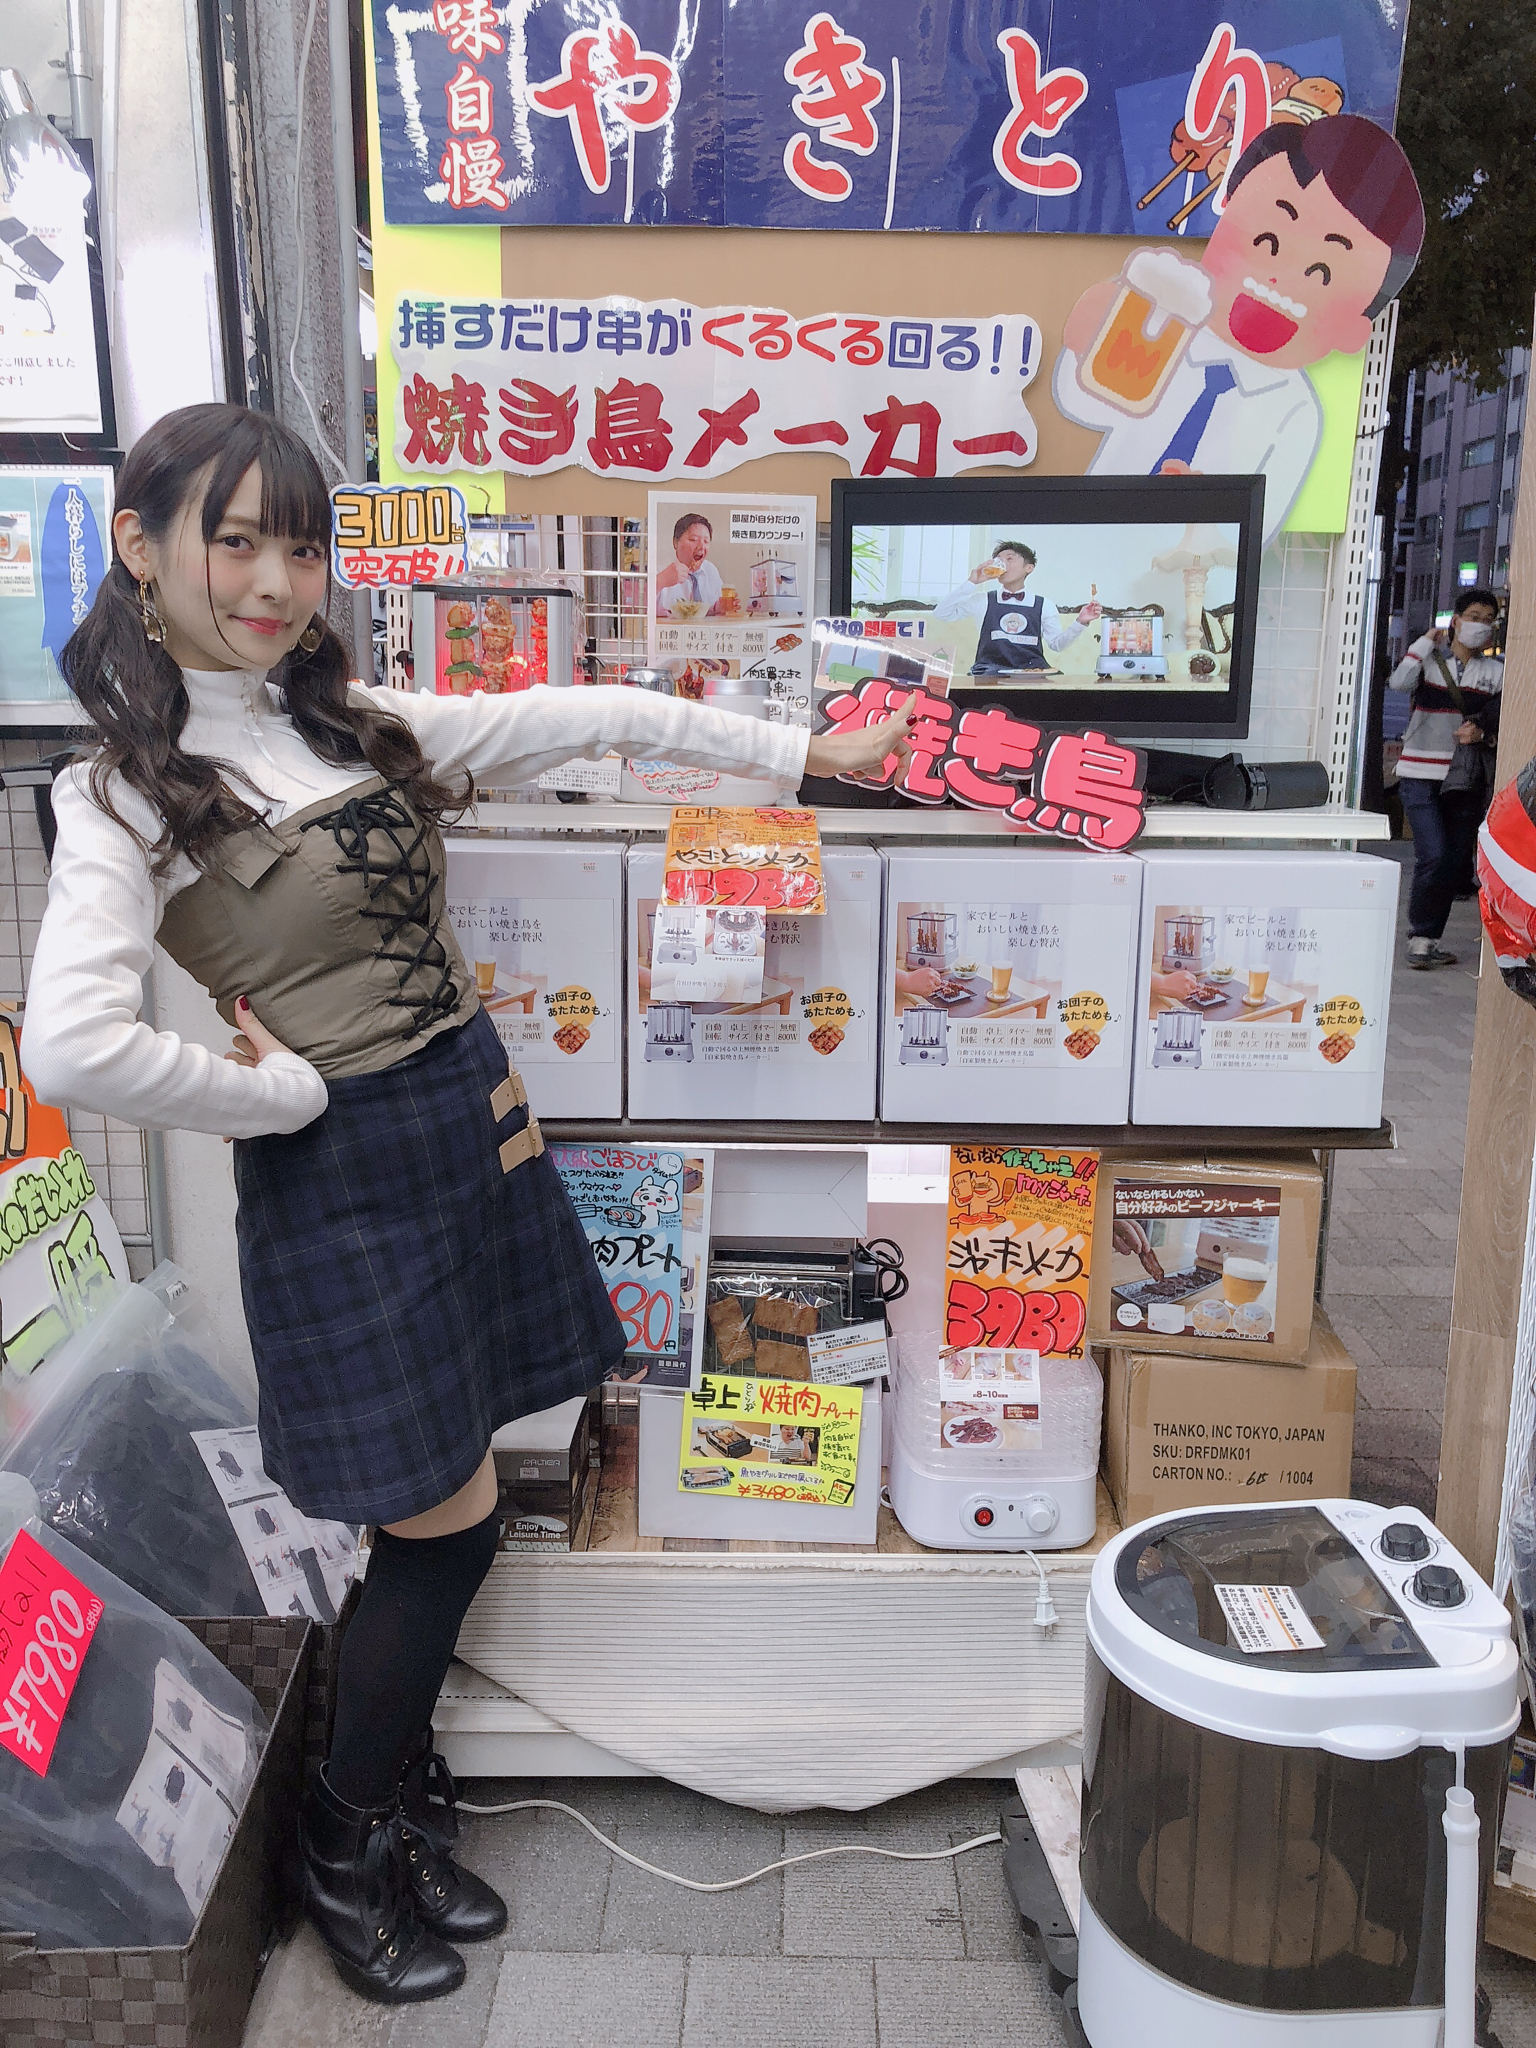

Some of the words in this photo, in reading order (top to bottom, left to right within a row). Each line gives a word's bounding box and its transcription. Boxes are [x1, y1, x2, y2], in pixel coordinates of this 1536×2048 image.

[528, 12, 1272, 214] やきとり
[399, 300, 1034, 377] 挿すだけ串がくるくる回る!!
[404, 374, 1029, 478] 焼き鳥メーカー
[732, 514, 800, 525] 部屋が自分だけの
[731, 530, 804, 541] 焼き鳥カウンター!
[659, 631, 679, 640] 自動
[688, 632, 706, 641] 卓上
[714, 632, 738, 641] タイマー
[659, 641, 679, 651] 回転
[686, 643, 709, 652] サイズ
[717, 643, 734, 652] 付き
[742, 644, 765, 653] 800W
[966, 911, 1028, 921] 家でビールと
[1225, 914, 1287, 925] 家でビールと
[457, 918, 541, 930] おいしい焼き鳥を
[977, 924, 1060, 934] おいしい焼き鳥を
[489, 932, 542, 943] 楽しむ贅沢
[1235, 928, 1318, 939] おいしい焼き鳥を
[1007, 937, 1060, 948] 楽しむ贅沢
[544, 991, 591, 1004] お団子の
[800, 992, 847, 1006] お団子の
[1057, 996, 1104, 1009] お団子の
[1313, 1000, 1360, 1013] お団子の
[522, 1031, 543, 1040] 800W
[728, 1033, 749, 1041] サイズ
[755, 1033, 771, 1041] 付き
[777, 1033, 798, 1041] 800W
[983, 1036, 1005, 1044] サイズ
[1010, 1036, 1026, 1045] 付き
[1033, 1037, 1053, 1045] 800W
[1238, 1040, 1259, 1048] サイズ
[1265, 1040, 1281, 1049] 付き
[1115, 1189, 1205, 1201] ないなら作るしかない
[1115, 1197, 1280, 1215] 自分好みのビーフジャーキー
[691, 1377, 741, 1411] 卓上
[1153, 1423, 1209, 1440] THANKO,
[1211, 1424, 1233, 1439] INC
[1236, 1425, 1282, 1443] TOKYO,
[1284, 1427, 1326, 1442] JAPAN
[1152, 1444, 1183, 1459] SKU:
[1185, 1445, 1251, 1461] DRFDMK01
[1152, 1465, 1204, 1481] CARTON
[515, 1522, 540, 1531] Enjoy
[541, 1522, 561, 1531] Your
[508, 1530, 539, 1539] Leisure
[540, 1531, 561, 1539] Time
